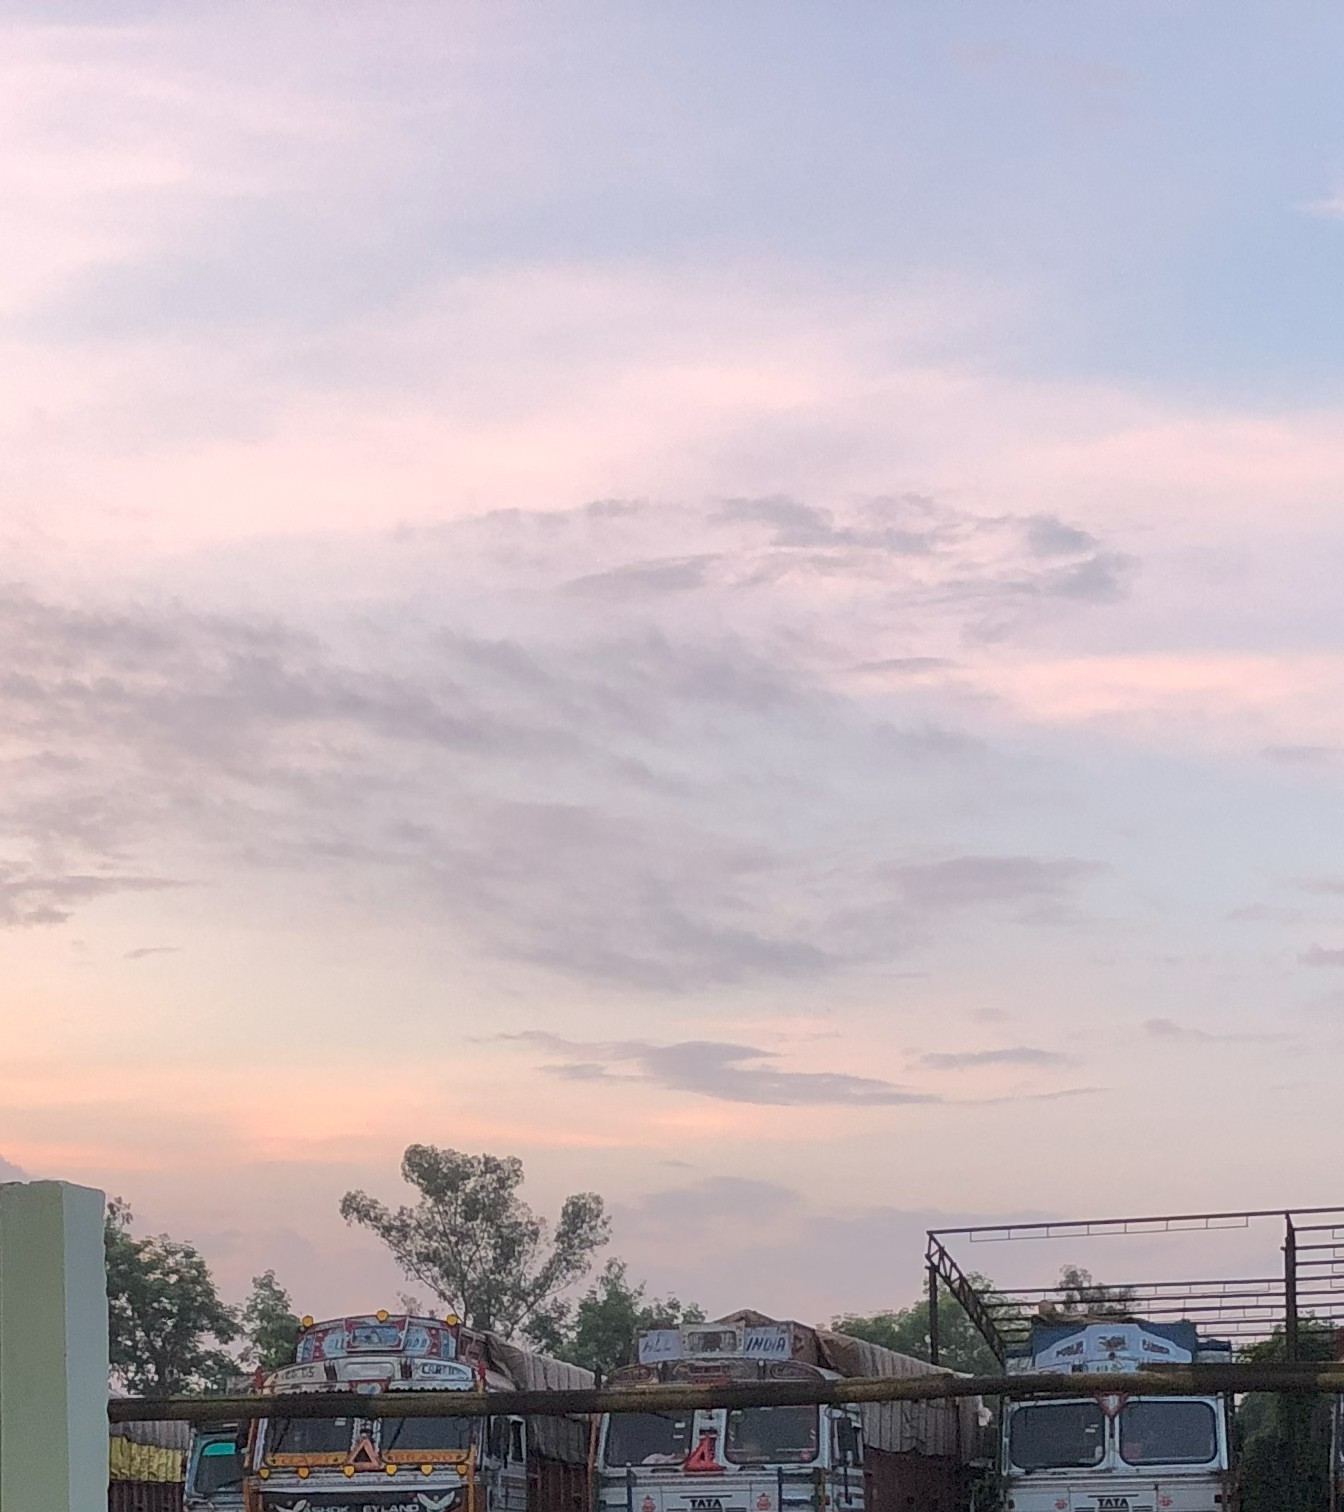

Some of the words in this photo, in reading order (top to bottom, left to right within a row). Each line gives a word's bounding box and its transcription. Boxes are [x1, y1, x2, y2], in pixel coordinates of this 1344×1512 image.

[746, 1336, 786, 1352] INDIA
[690, 1498, 722, 1508] TATA
[1097, 1498, 1129, 1507] TATA
